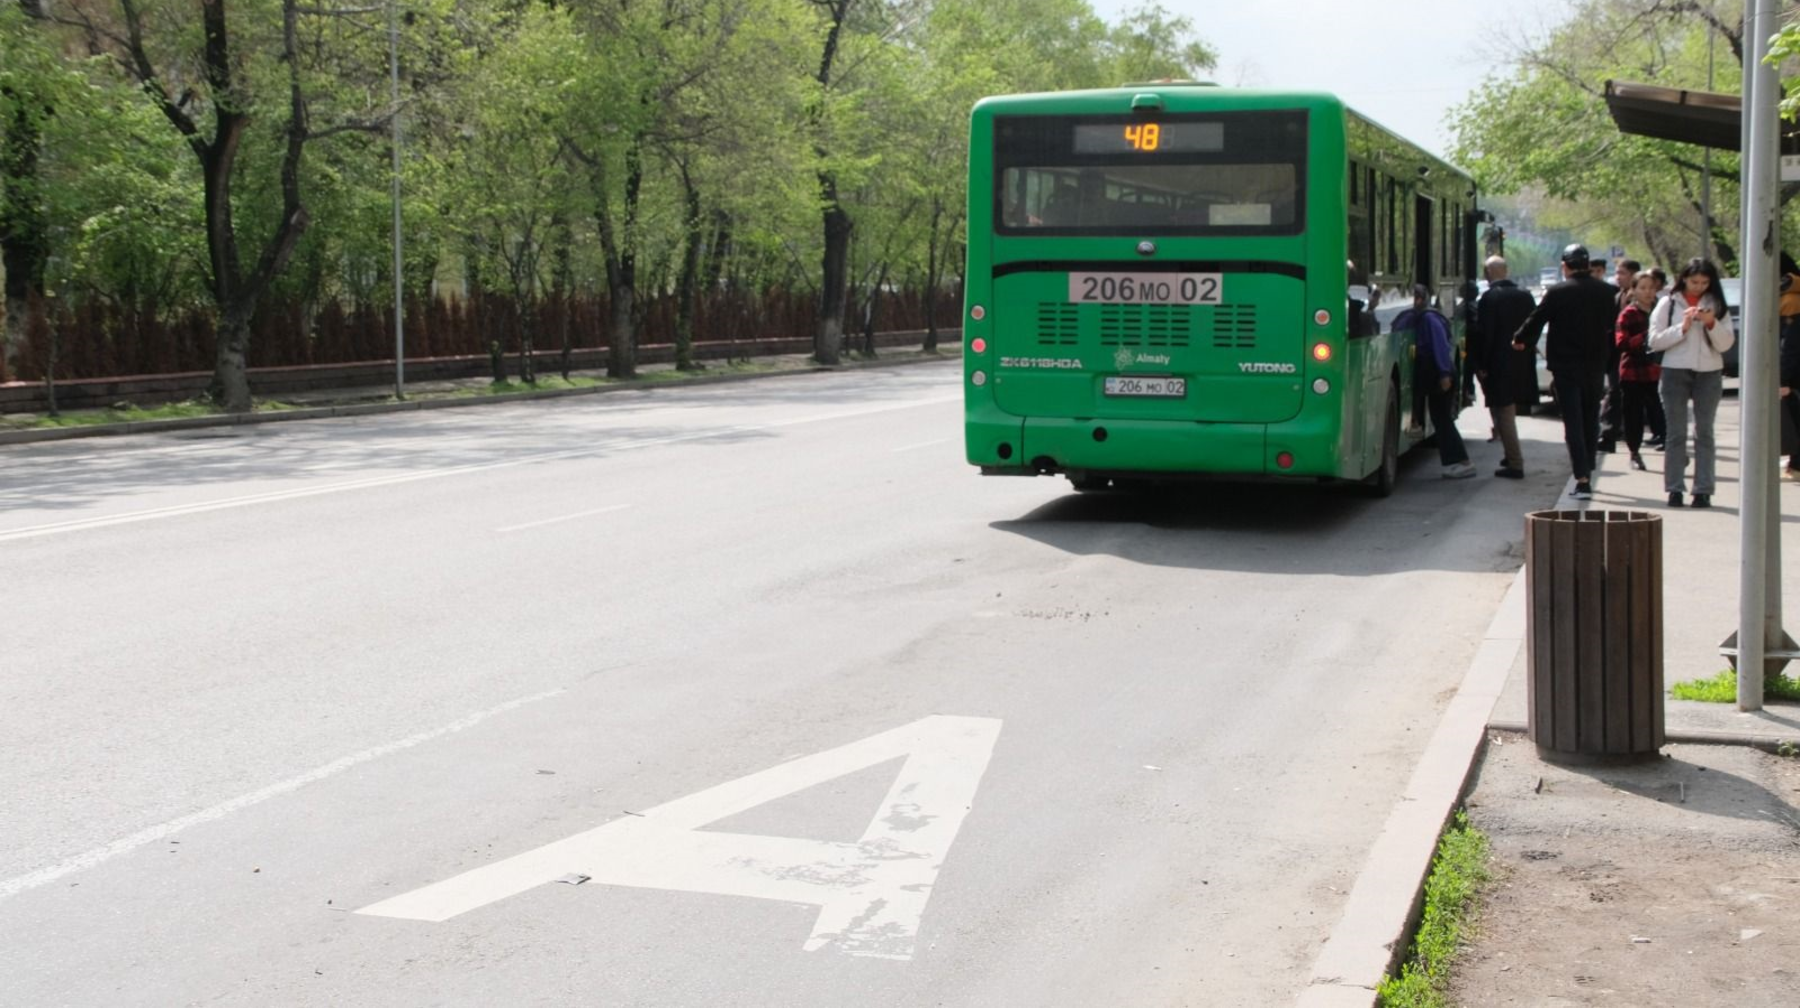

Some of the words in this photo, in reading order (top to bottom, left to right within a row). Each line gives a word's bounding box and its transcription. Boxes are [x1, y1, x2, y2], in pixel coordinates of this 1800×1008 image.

[1125, 123, 1159, 150] 48
[1082, 277, 1135, 301] 206
[1139, 282, 1171, 301] MO
[1180, 277, 1218, 302] 02
[1135, 353, 1170, 366] Almaty
[1238, 362, 1296, 374] YUTONG
[1118, 380, 1142, 393] 206
[1146, 383, 1162, 393] MO
[1166, 381, 1184, 394] 02
[353, 714, 1003, 961] A
